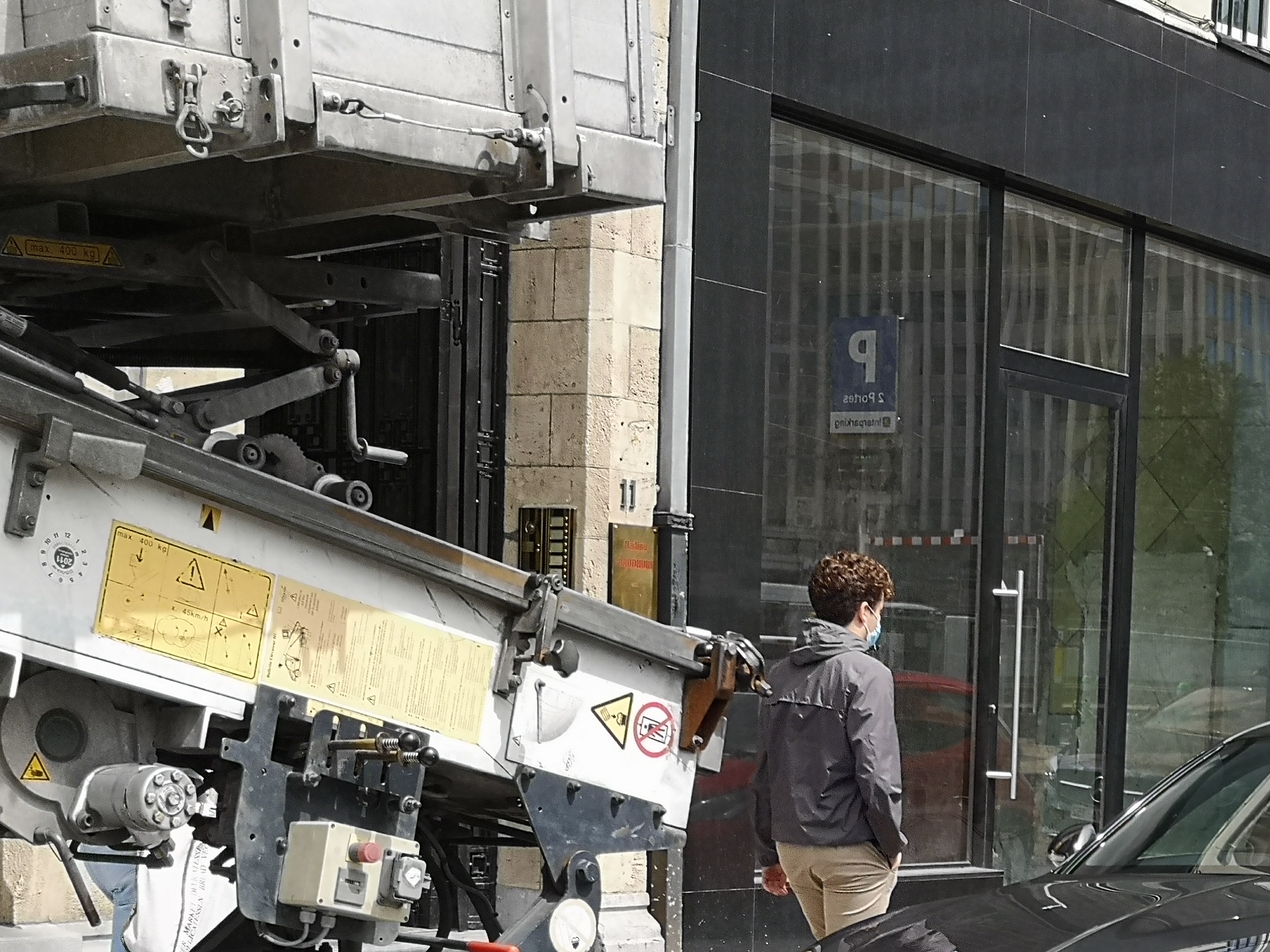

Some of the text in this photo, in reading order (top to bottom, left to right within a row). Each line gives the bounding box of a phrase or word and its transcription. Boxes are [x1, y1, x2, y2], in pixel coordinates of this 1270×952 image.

[60, 246, 77, 256] 400
[83, 248, 95, 260] kg
[140, 538, 153, 547] 400
[157, 543, 167, 553] kg
[56, 555, 73, 566] 2011
[182, 608, 209, 622] 45km/h
